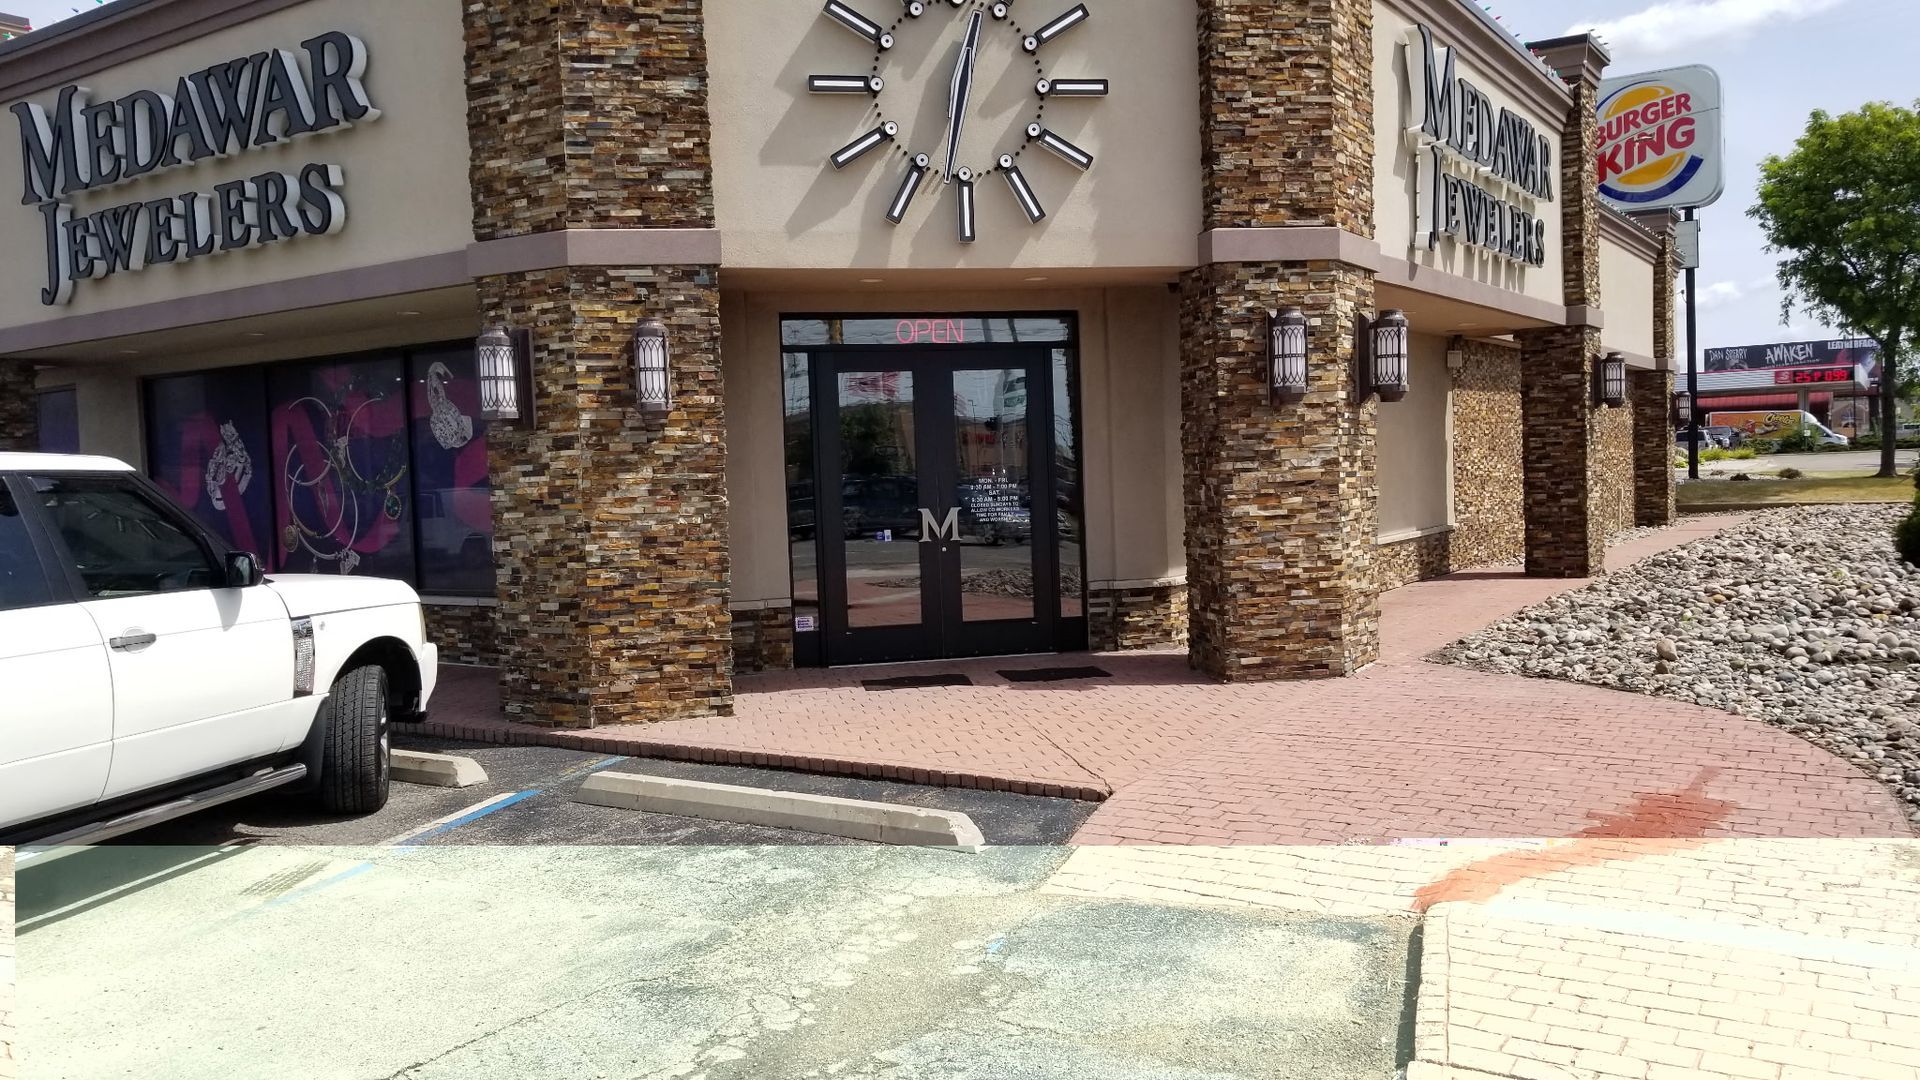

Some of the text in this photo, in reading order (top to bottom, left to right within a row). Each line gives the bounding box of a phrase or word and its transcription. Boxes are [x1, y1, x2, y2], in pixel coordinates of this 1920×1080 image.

[10, 31, 380, 204] MEDAWAR
[1412, 23, 1553, 202] MEDAWAR
[1596, 93, 1692, 149] BURGER
[1597, 117, 1696, 184] KING
[40, 163, 343, 305] JEWELERS
[1424, 145, 1545, 268] JEWELERS
[896, 319, 963, 344] OPEN
[1709, 349, 1724, 362] DAN
[1765, 343, 1813, 365] AWAKEN
[917, 507, 963, 543] M
